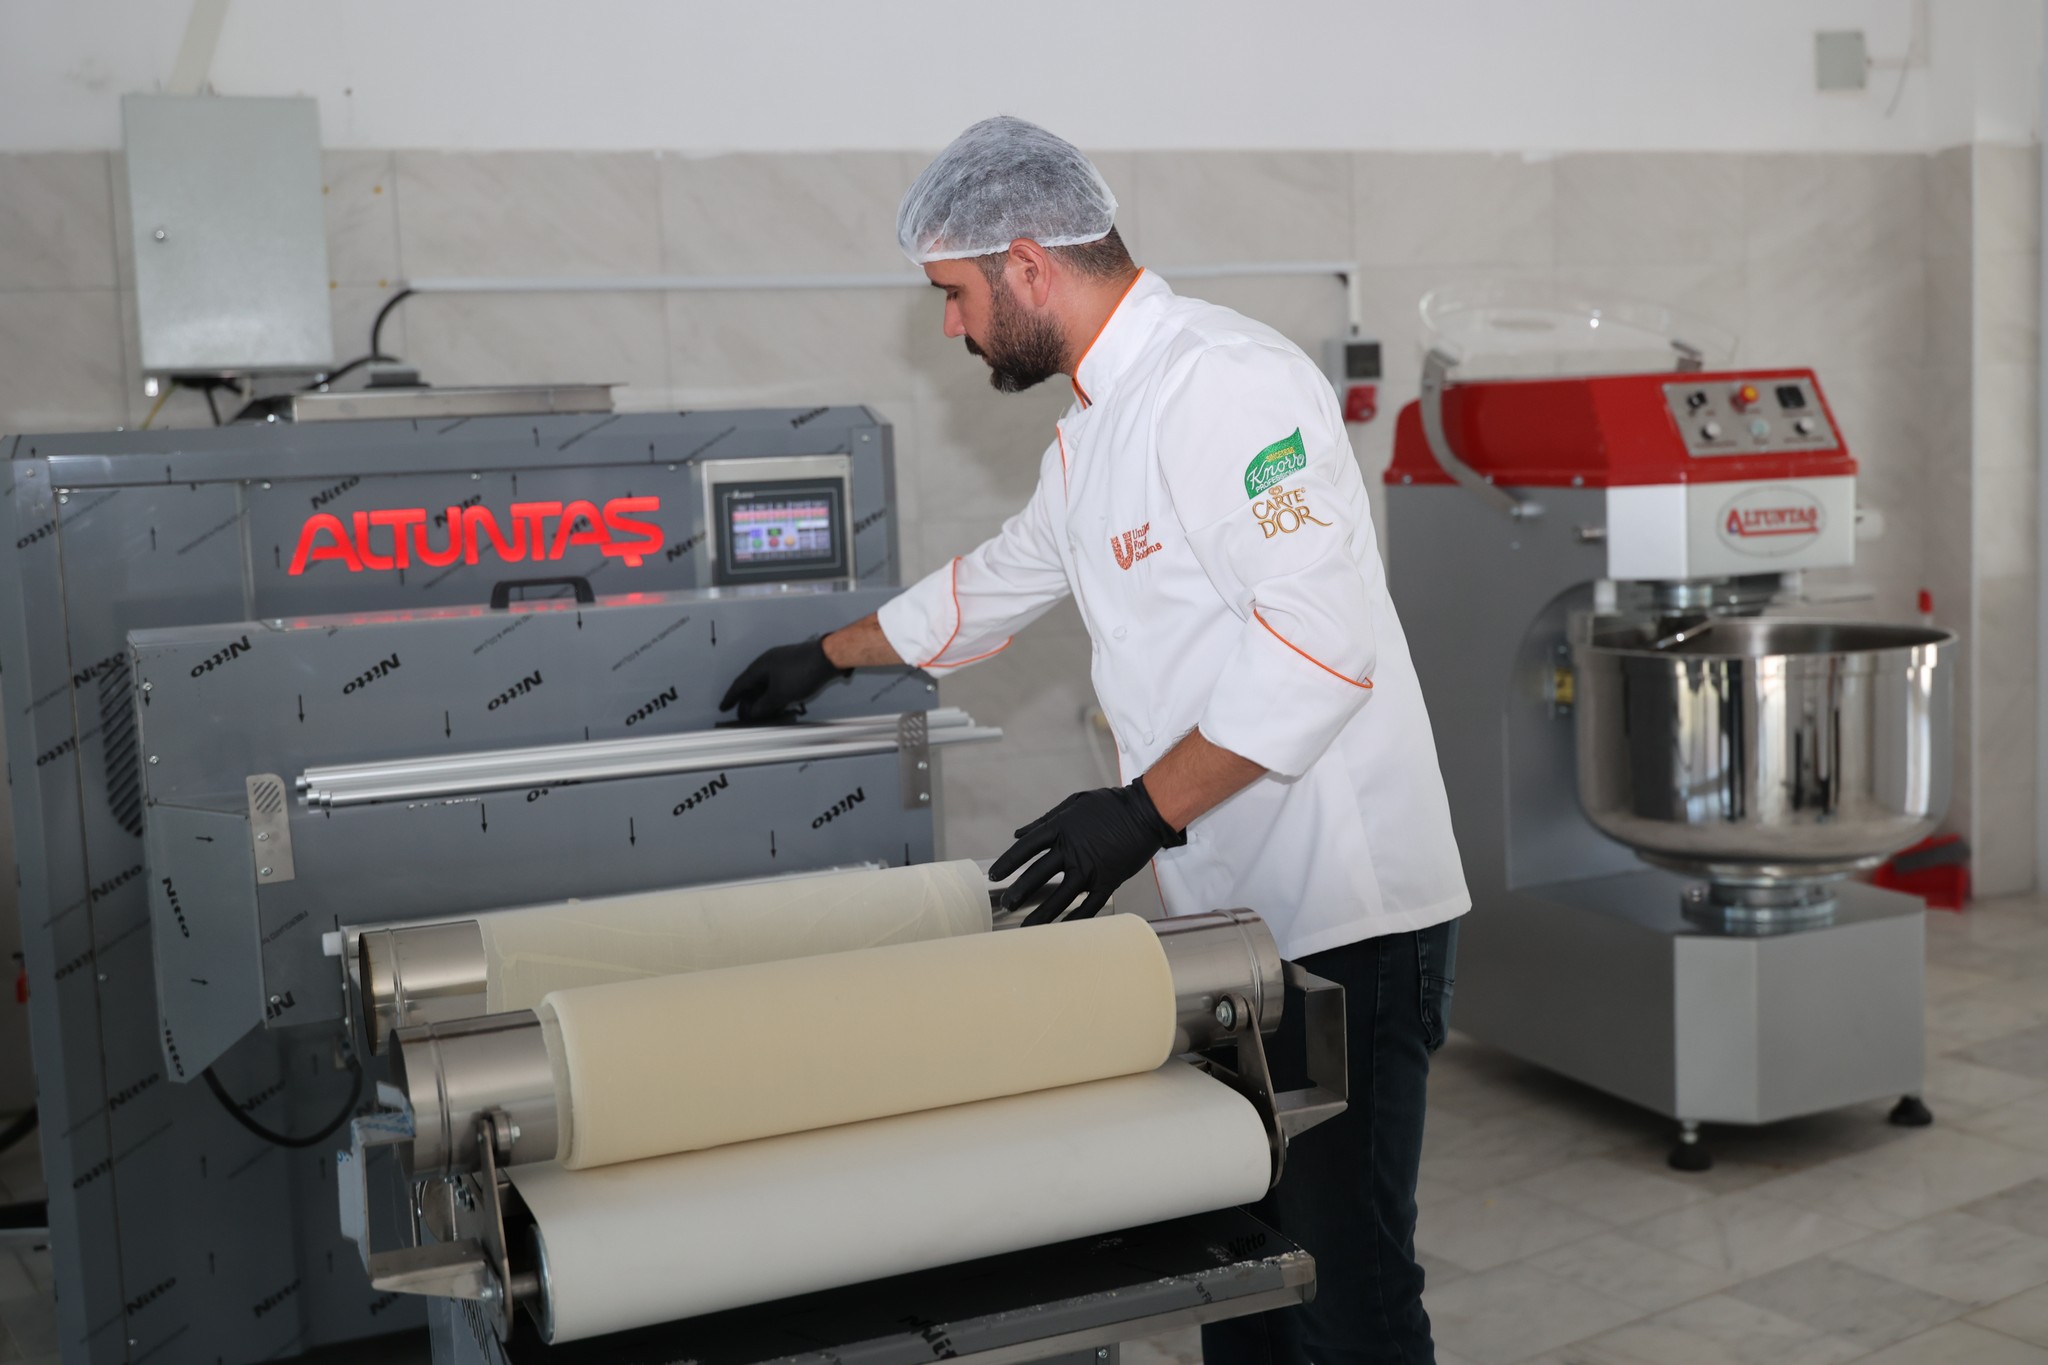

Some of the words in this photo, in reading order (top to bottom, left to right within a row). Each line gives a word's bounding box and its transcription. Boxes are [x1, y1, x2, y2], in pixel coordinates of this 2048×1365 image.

[1246, 453, 1305, 490] Knorr
[309, 474, 360, 510] Nitto
[1252, 488, 1305, 520] CARTE
[288, 496, 665, 576] ALTUNTAŞ
[1257, 505, 1334, 539] D'OR
[190, 635, 252, 678] Nitto
[342, 653, 401, 694] Nitto
[487, 670, 543, 711] Nitto
[625, 686, 679, 726] Nitto
[672, 772, 729, 817] Nitto
[811, 786, 866, 830] Nitto
[90, 864, 143, 903] Nitto
[161, 877, 190, 938] Nitto
[1227, 1233, 1266, 1258] Nitto
